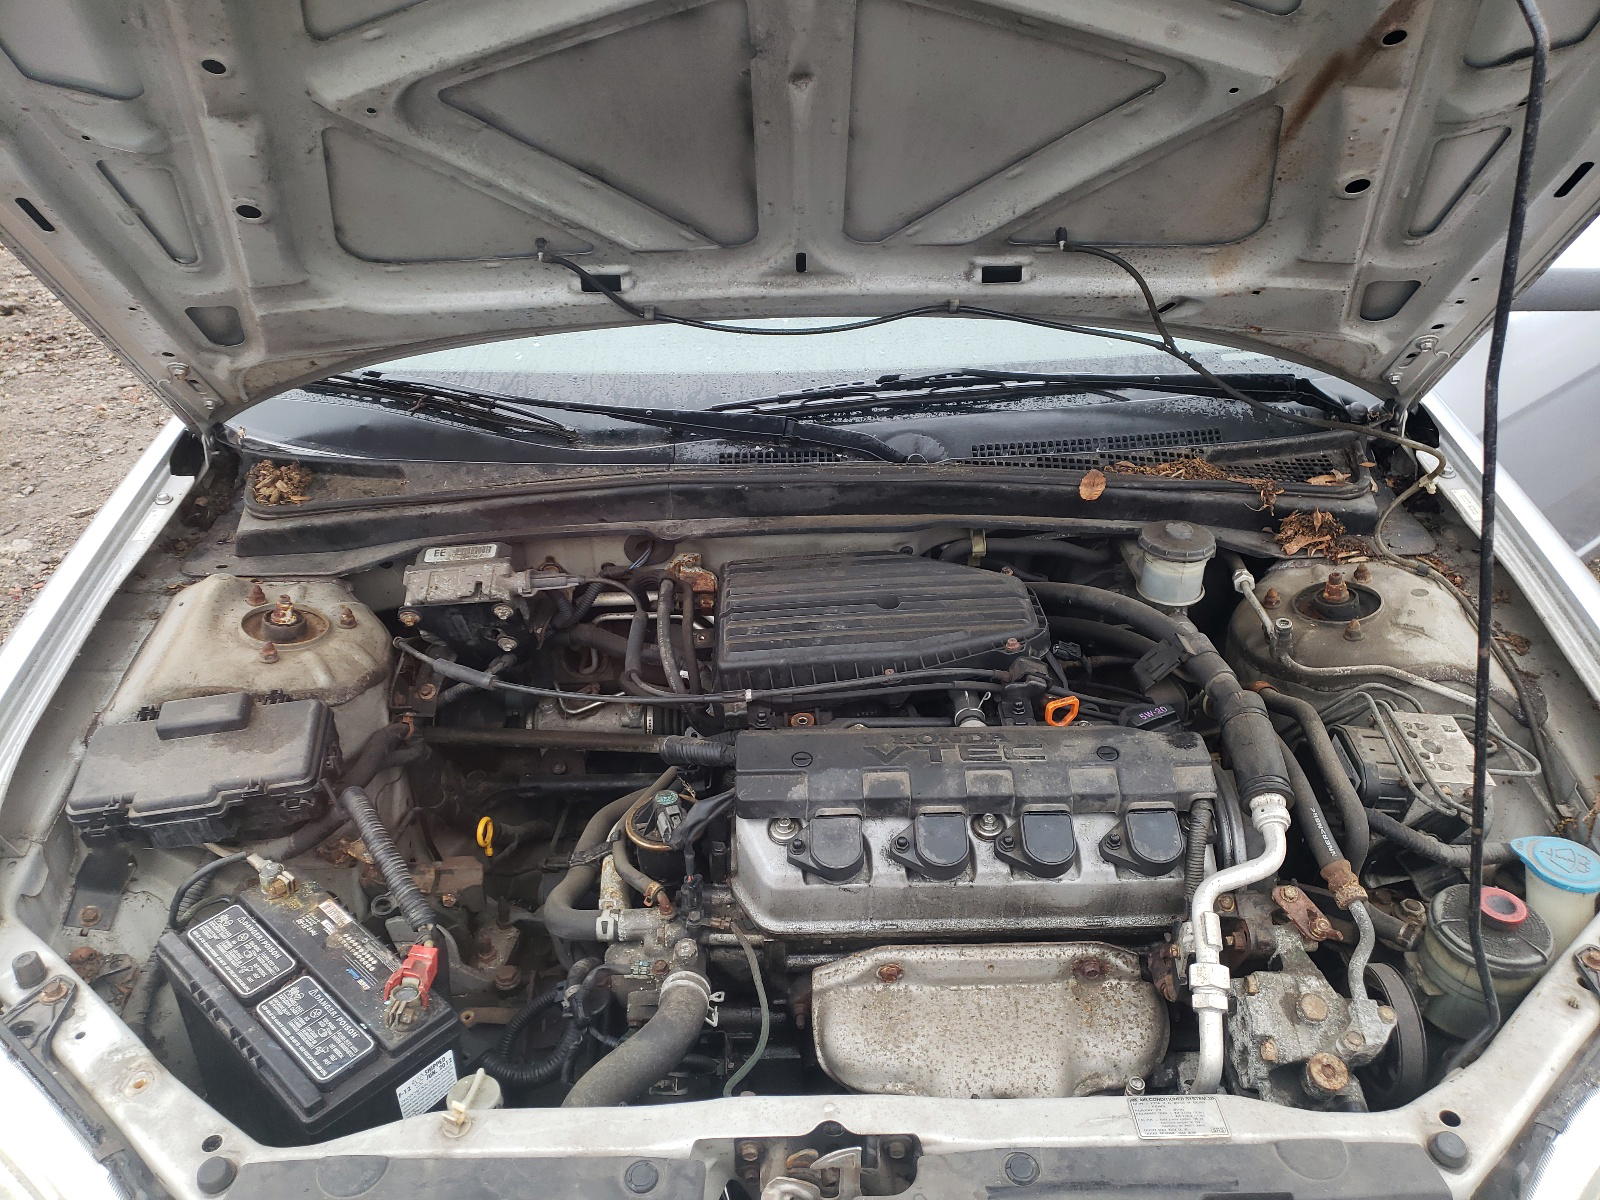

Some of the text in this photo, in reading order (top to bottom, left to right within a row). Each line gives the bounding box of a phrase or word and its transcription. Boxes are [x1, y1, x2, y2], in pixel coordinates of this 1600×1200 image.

[434, 549, 447, 557] EE
[1138, 706, 1168, 721] 5W-20
[863, 742, 1047, 765] VTEC
[314, 991, 359, 1039] DANGER/POISON
[424, 1056, 446, 1075] SHIPPED
